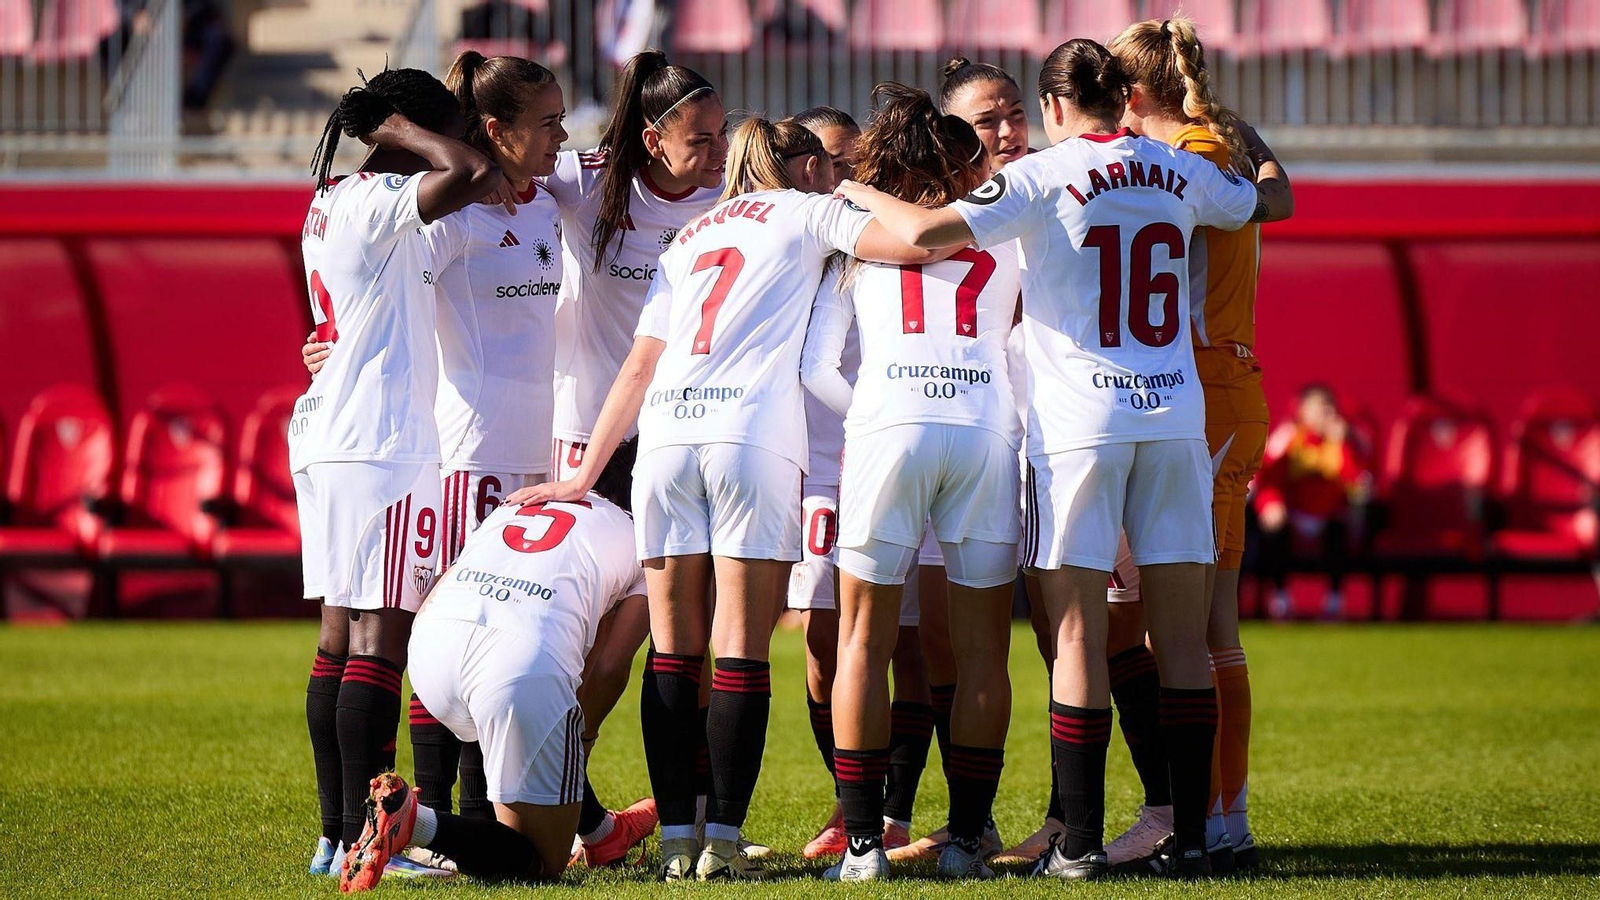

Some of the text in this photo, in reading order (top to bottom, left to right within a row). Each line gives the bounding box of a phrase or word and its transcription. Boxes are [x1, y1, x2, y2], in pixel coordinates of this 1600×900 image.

[1066, 160, 1188, 207] I.ARNAIZ
[690, 247, 746, 355] 7
[881, 247, 997, 339] 17
[1081, 222, 1186, 348] 16
[887, 362, 990, 385] Cruzcampo
[923, 381, 956, 399] 0.0
[1092, 372, 1185, 390] Cruzcampo
[650, 386, 744, 407] Cruzcampo
[674, 403, 706, 419] 0.0
[1130, 391, 1161, 410] 0.0
[476, 475, 502, 524] 6
[414, 507, 437, 559] 9
[502, 500, 593, 554] 5
[802, 507, 837, 556] 0
[456, 567, 553, 600] Cruzcampo
[479, 583, 511, 602] 0.0
